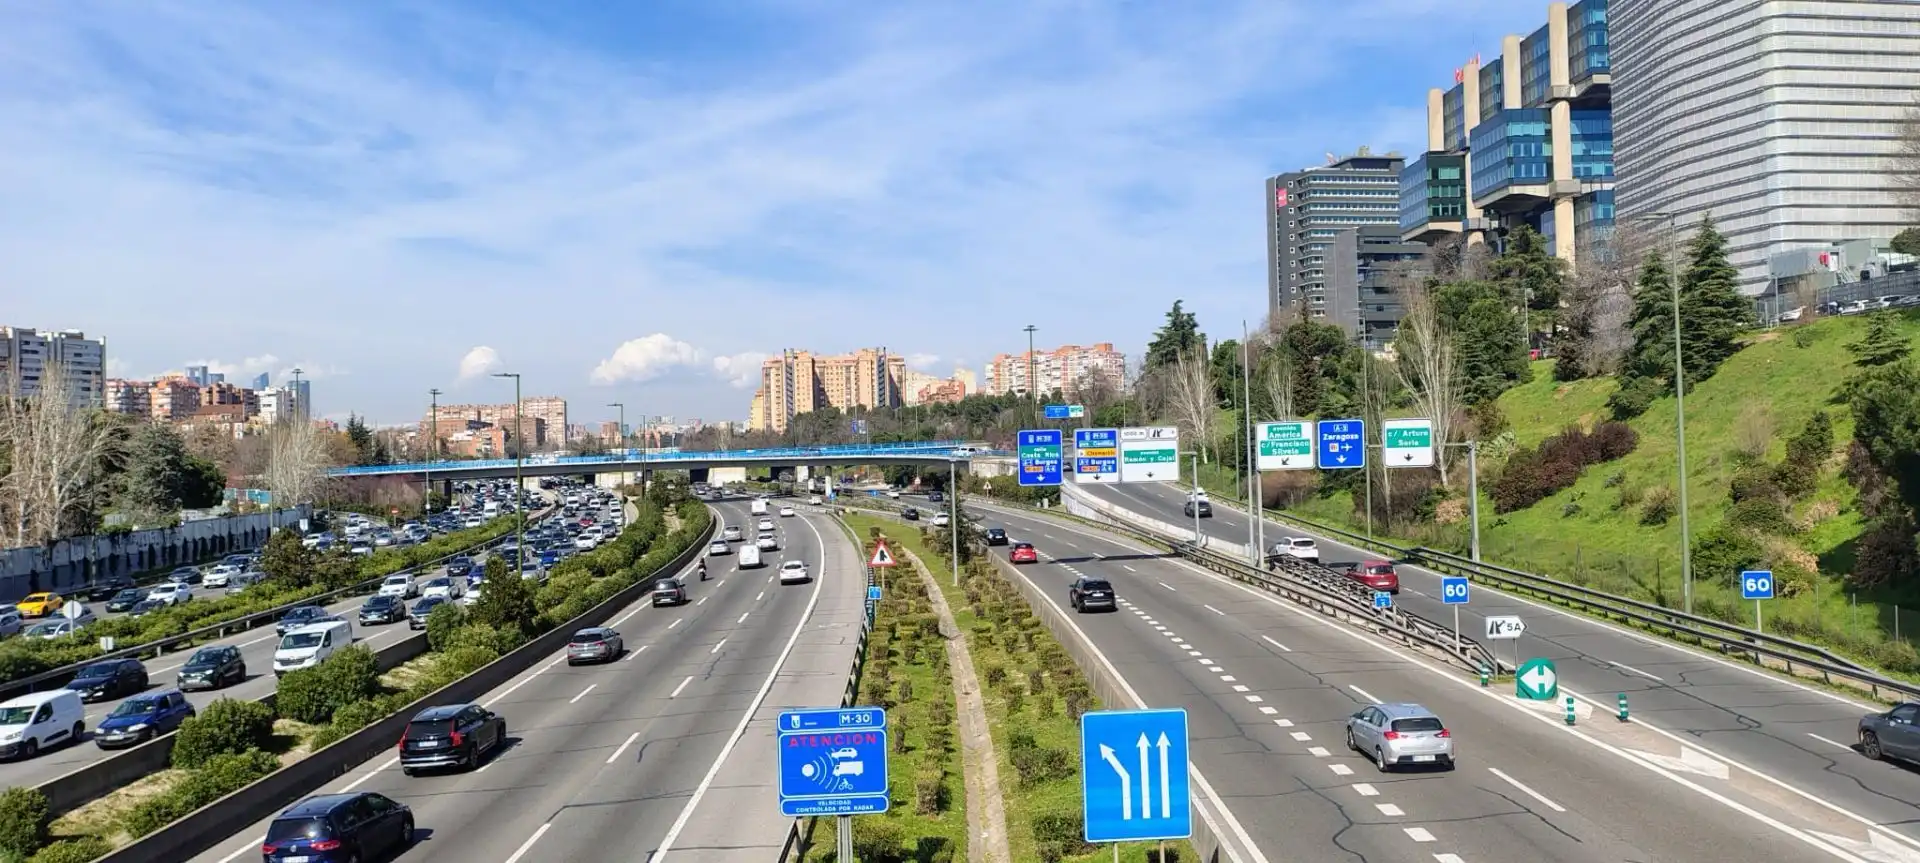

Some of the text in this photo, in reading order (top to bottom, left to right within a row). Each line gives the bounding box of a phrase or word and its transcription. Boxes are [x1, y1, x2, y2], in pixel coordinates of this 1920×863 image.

[1322, 433, 1359, 441] Zaragoza
[1402, 429, 1429, 437] Arturo
[1745, 578, 1770, 592] 60
[1445, 583, 1467, 597] 60
[1506, 622, 1521, 631] 5A
[841, 714, 870, 724] M-30
